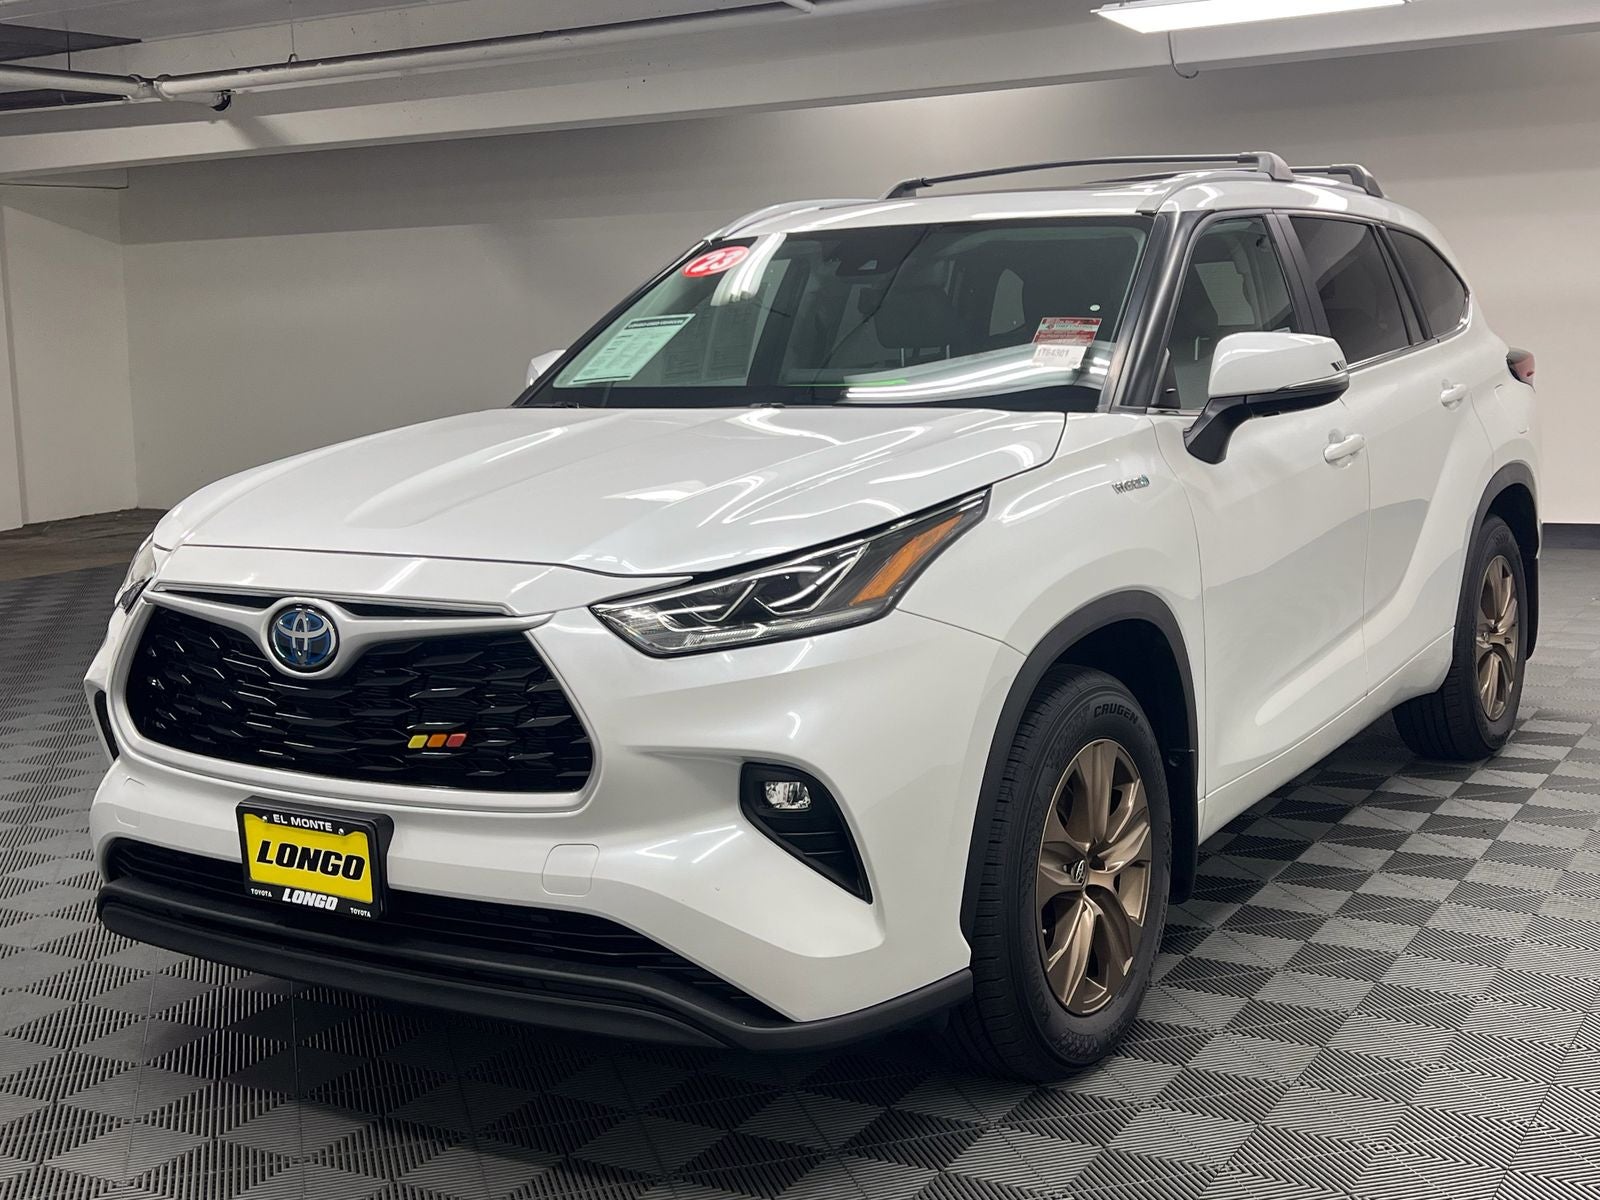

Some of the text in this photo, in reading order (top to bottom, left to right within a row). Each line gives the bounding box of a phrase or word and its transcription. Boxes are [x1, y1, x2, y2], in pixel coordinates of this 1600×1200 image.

[690, 250, 744, 271] 23
[1094, 703, 1139, 724] CRUGEN
[272, 814, 333, 832] EL MONTE
[256, 840, 366, 881] LONGO
[250, 888, 372, 918] TOYOTA LONGO TOYOTA
